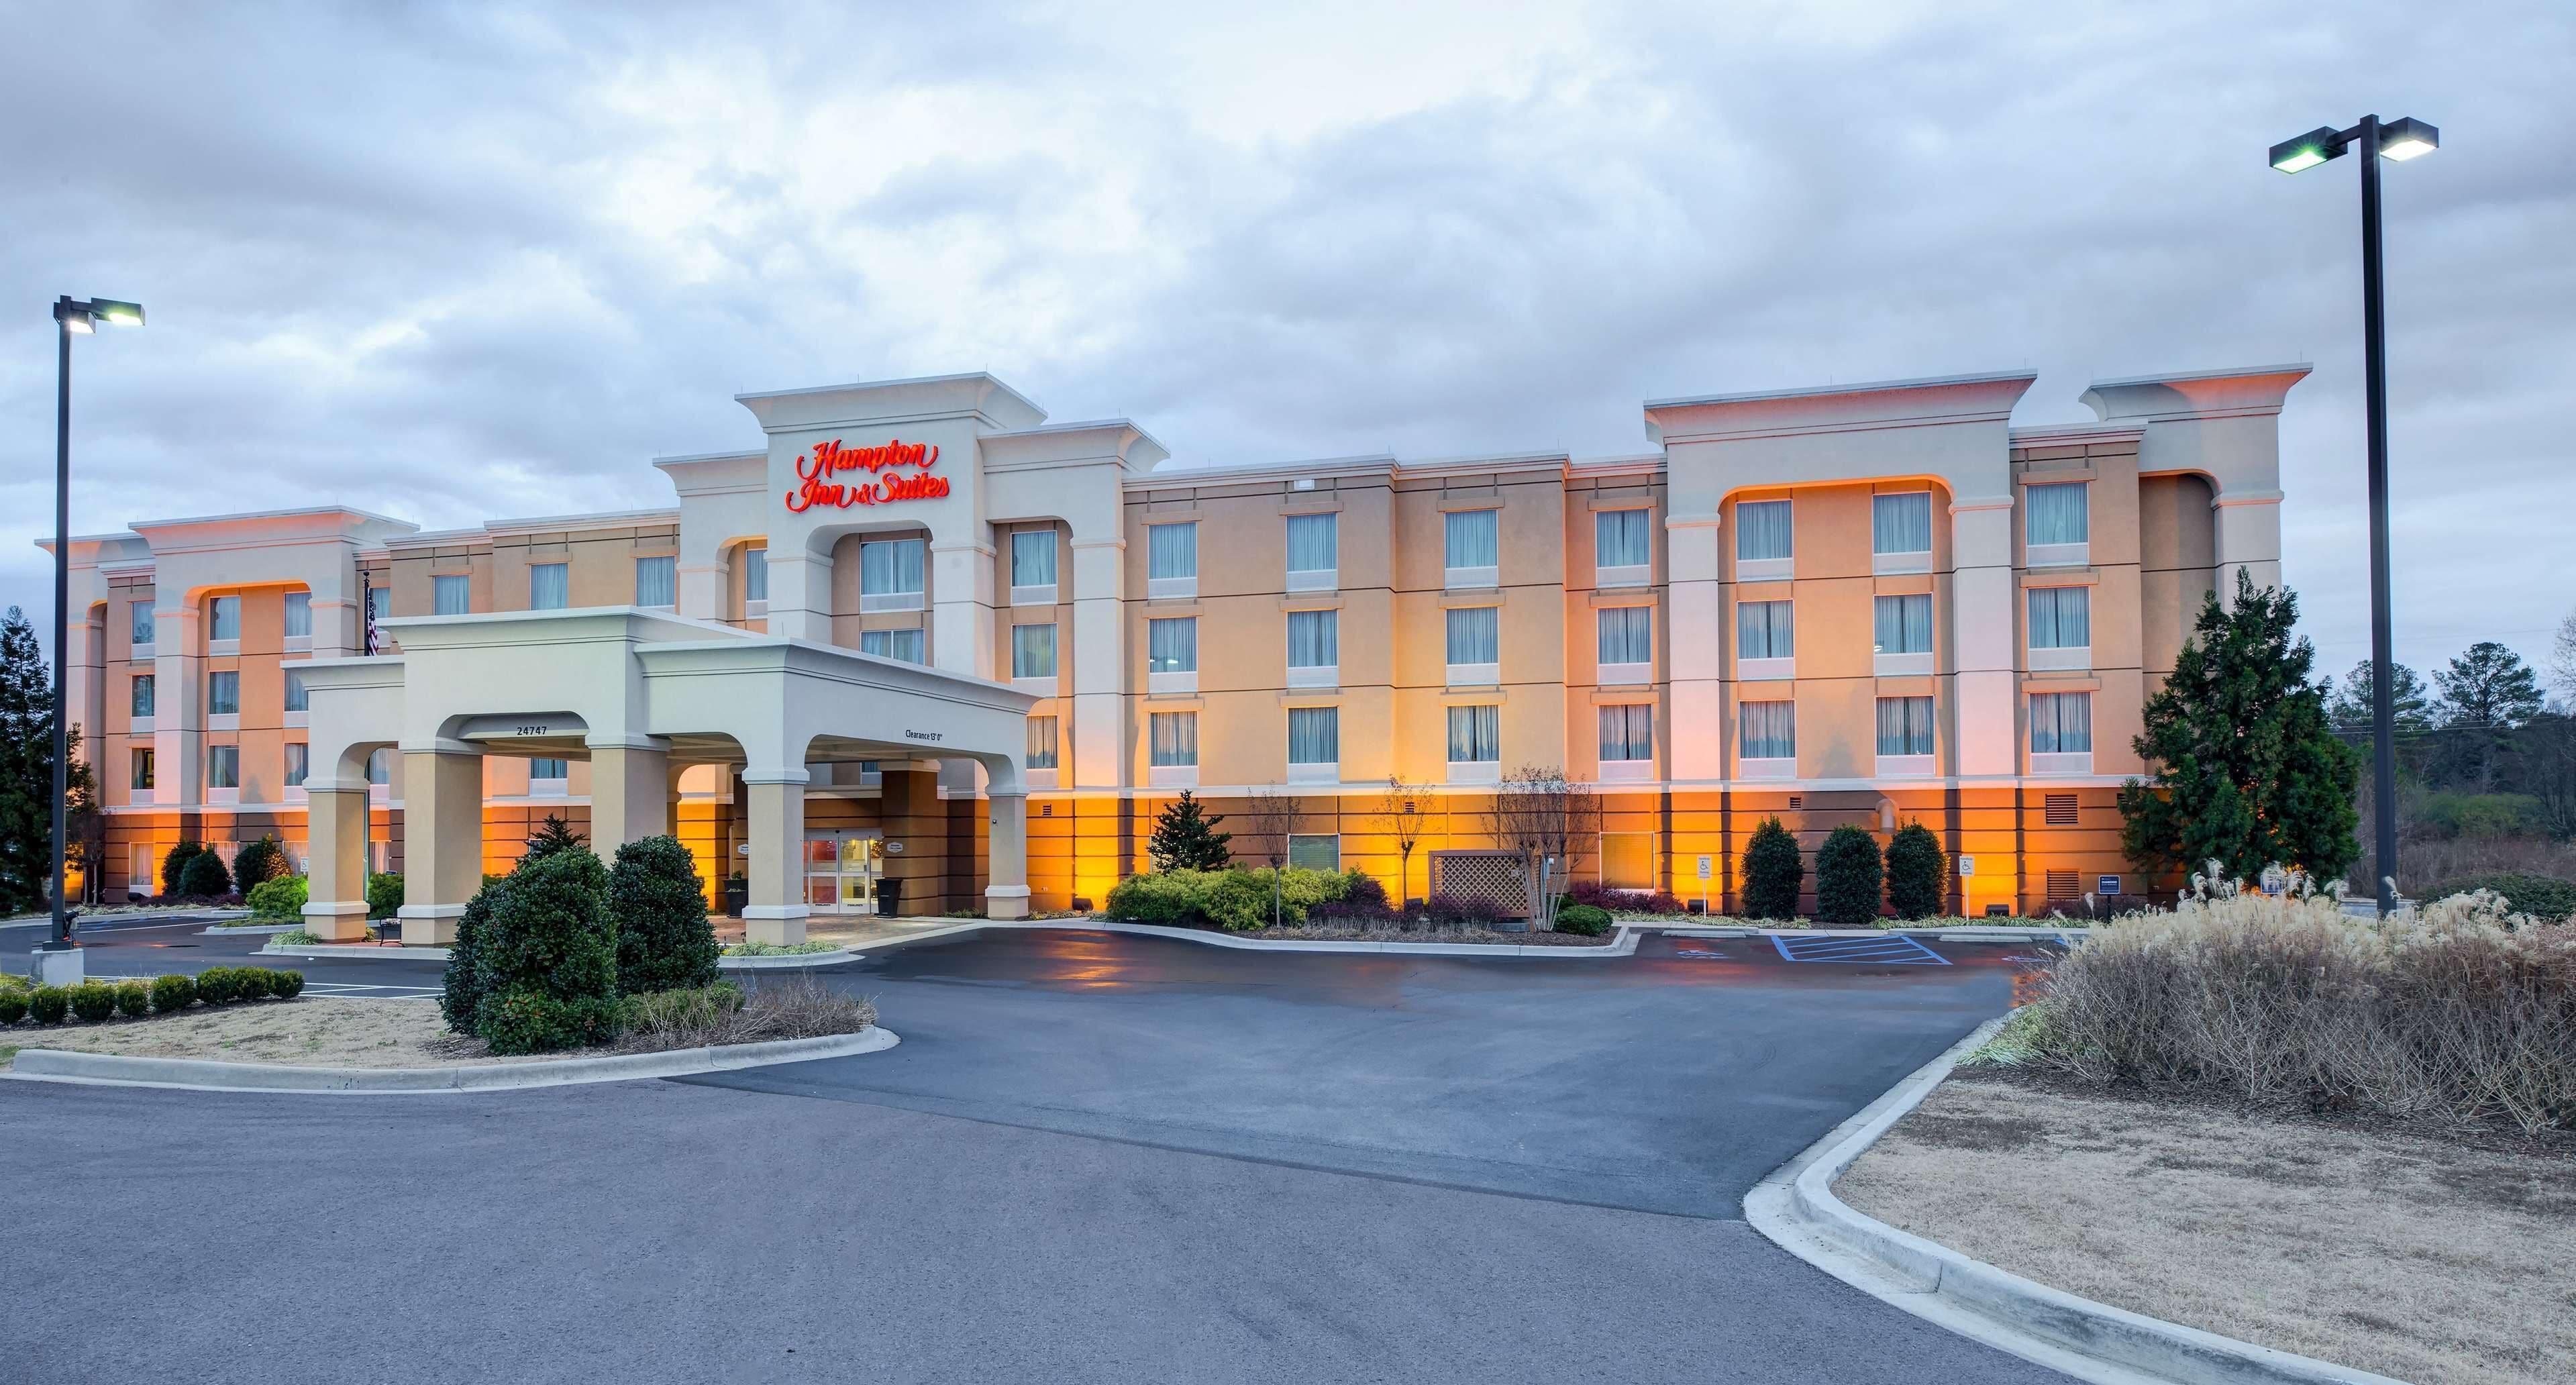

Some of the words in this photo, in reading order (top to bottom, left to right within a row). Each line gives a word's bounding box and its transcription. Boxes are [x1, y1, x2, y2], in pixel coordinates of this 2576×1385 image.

[796, 440, 939, 481] Hampton
[785, 478, 857, 513] Inn
[856, 483, 875, 505] &
[872, 472, 949, 503] Suites
[517, 726, 548, 735] 24747
[905, 729, 930, 740] Clearance
